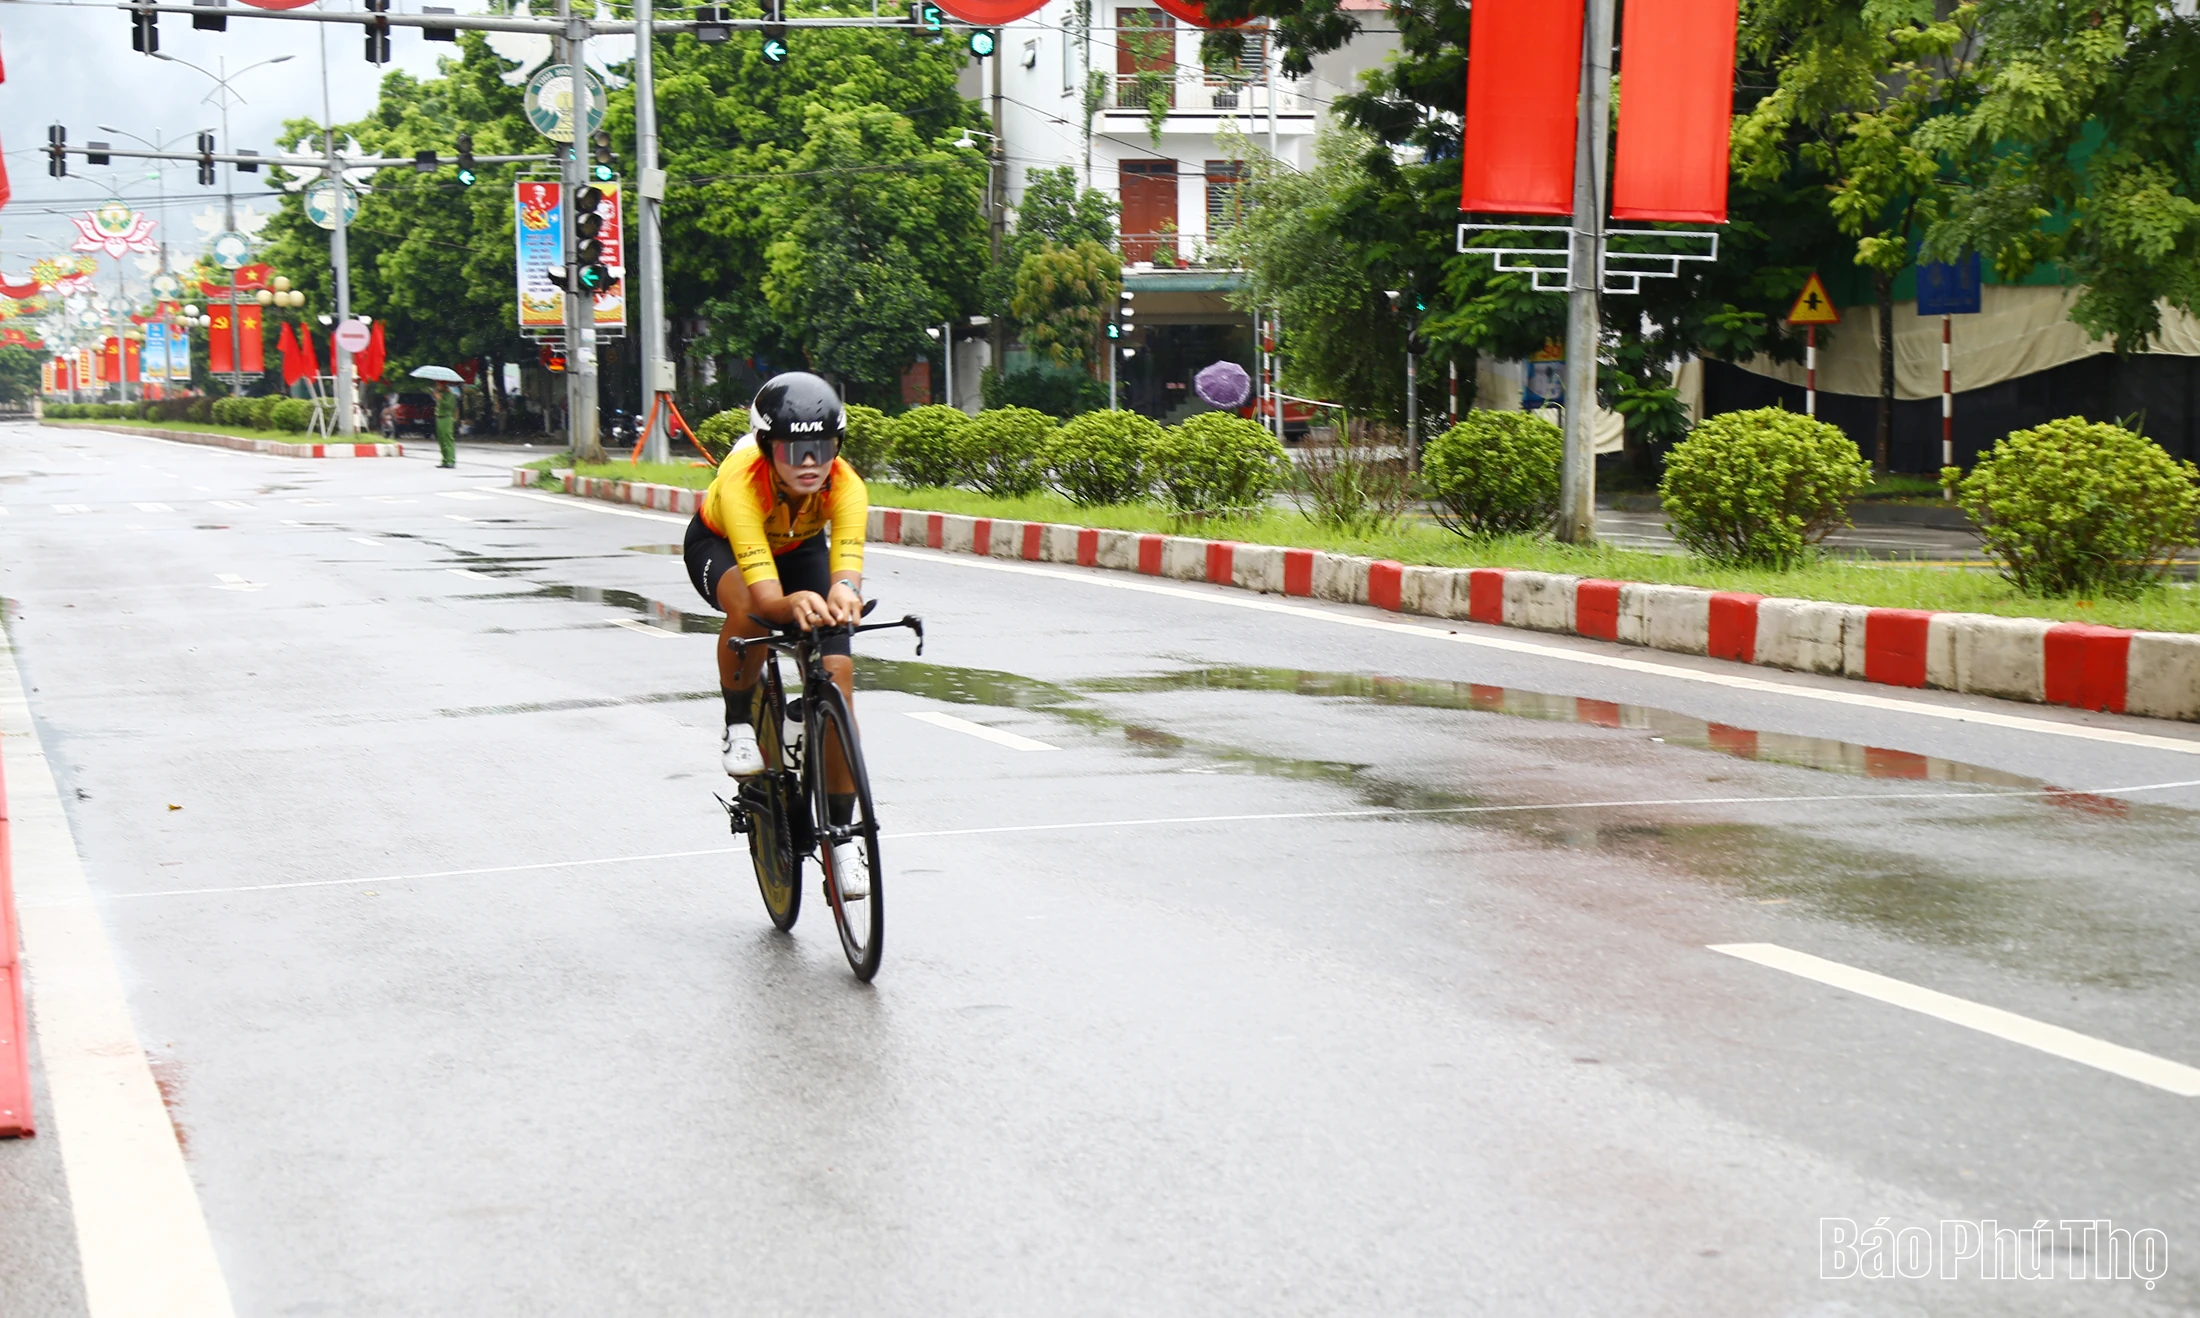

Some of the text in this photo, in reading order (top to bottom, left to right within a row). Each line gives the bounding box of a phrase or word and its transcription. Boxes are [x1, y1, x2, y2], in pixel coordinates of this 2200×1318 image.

[924, 7, 941, 31] 5
[790, 421, 824, 433] KASK
[737, 548, 767, 560] SUUNTO
